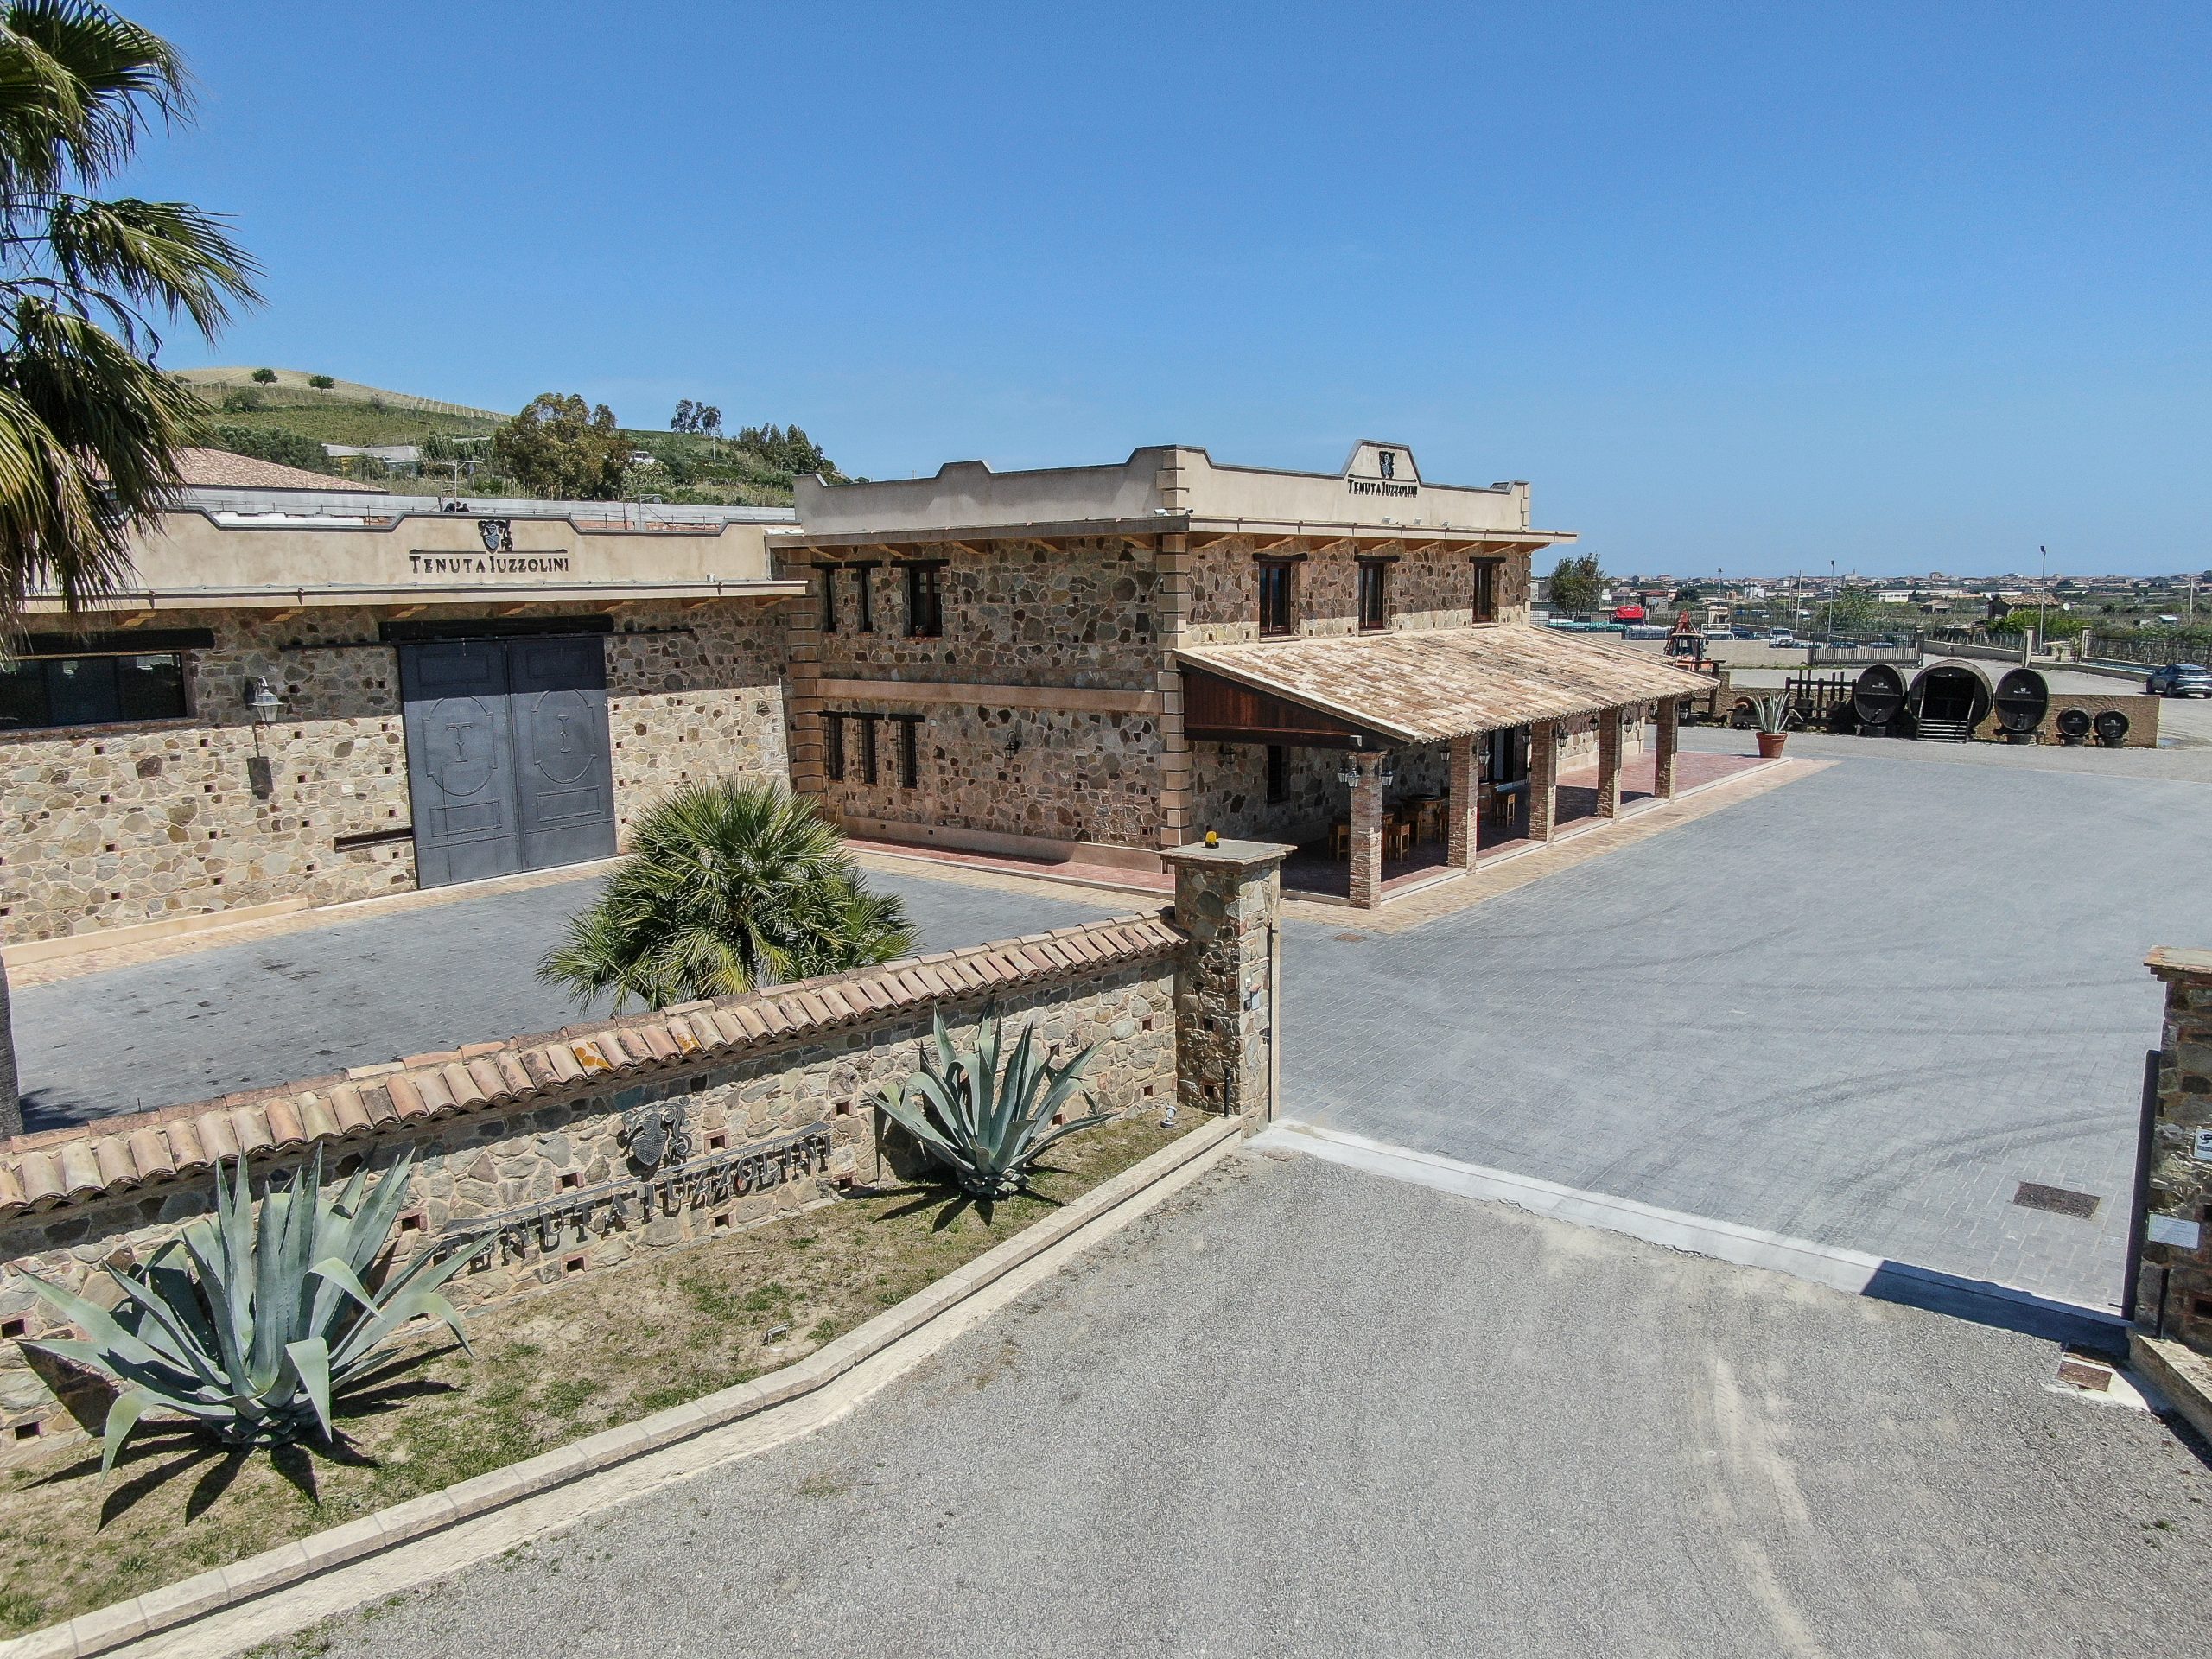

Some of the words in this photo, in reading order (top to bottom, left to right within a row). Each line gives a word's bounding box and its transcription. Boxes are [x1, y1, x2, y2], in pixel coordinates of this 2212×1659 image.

[1348, 479, 1382, 496] TENUTA
[409, 555, 486, 574] TENUTA
[488, 555, 569, 574] IUZZOLINI
[643, 1134, 833, 1210] IUZZOLINI
